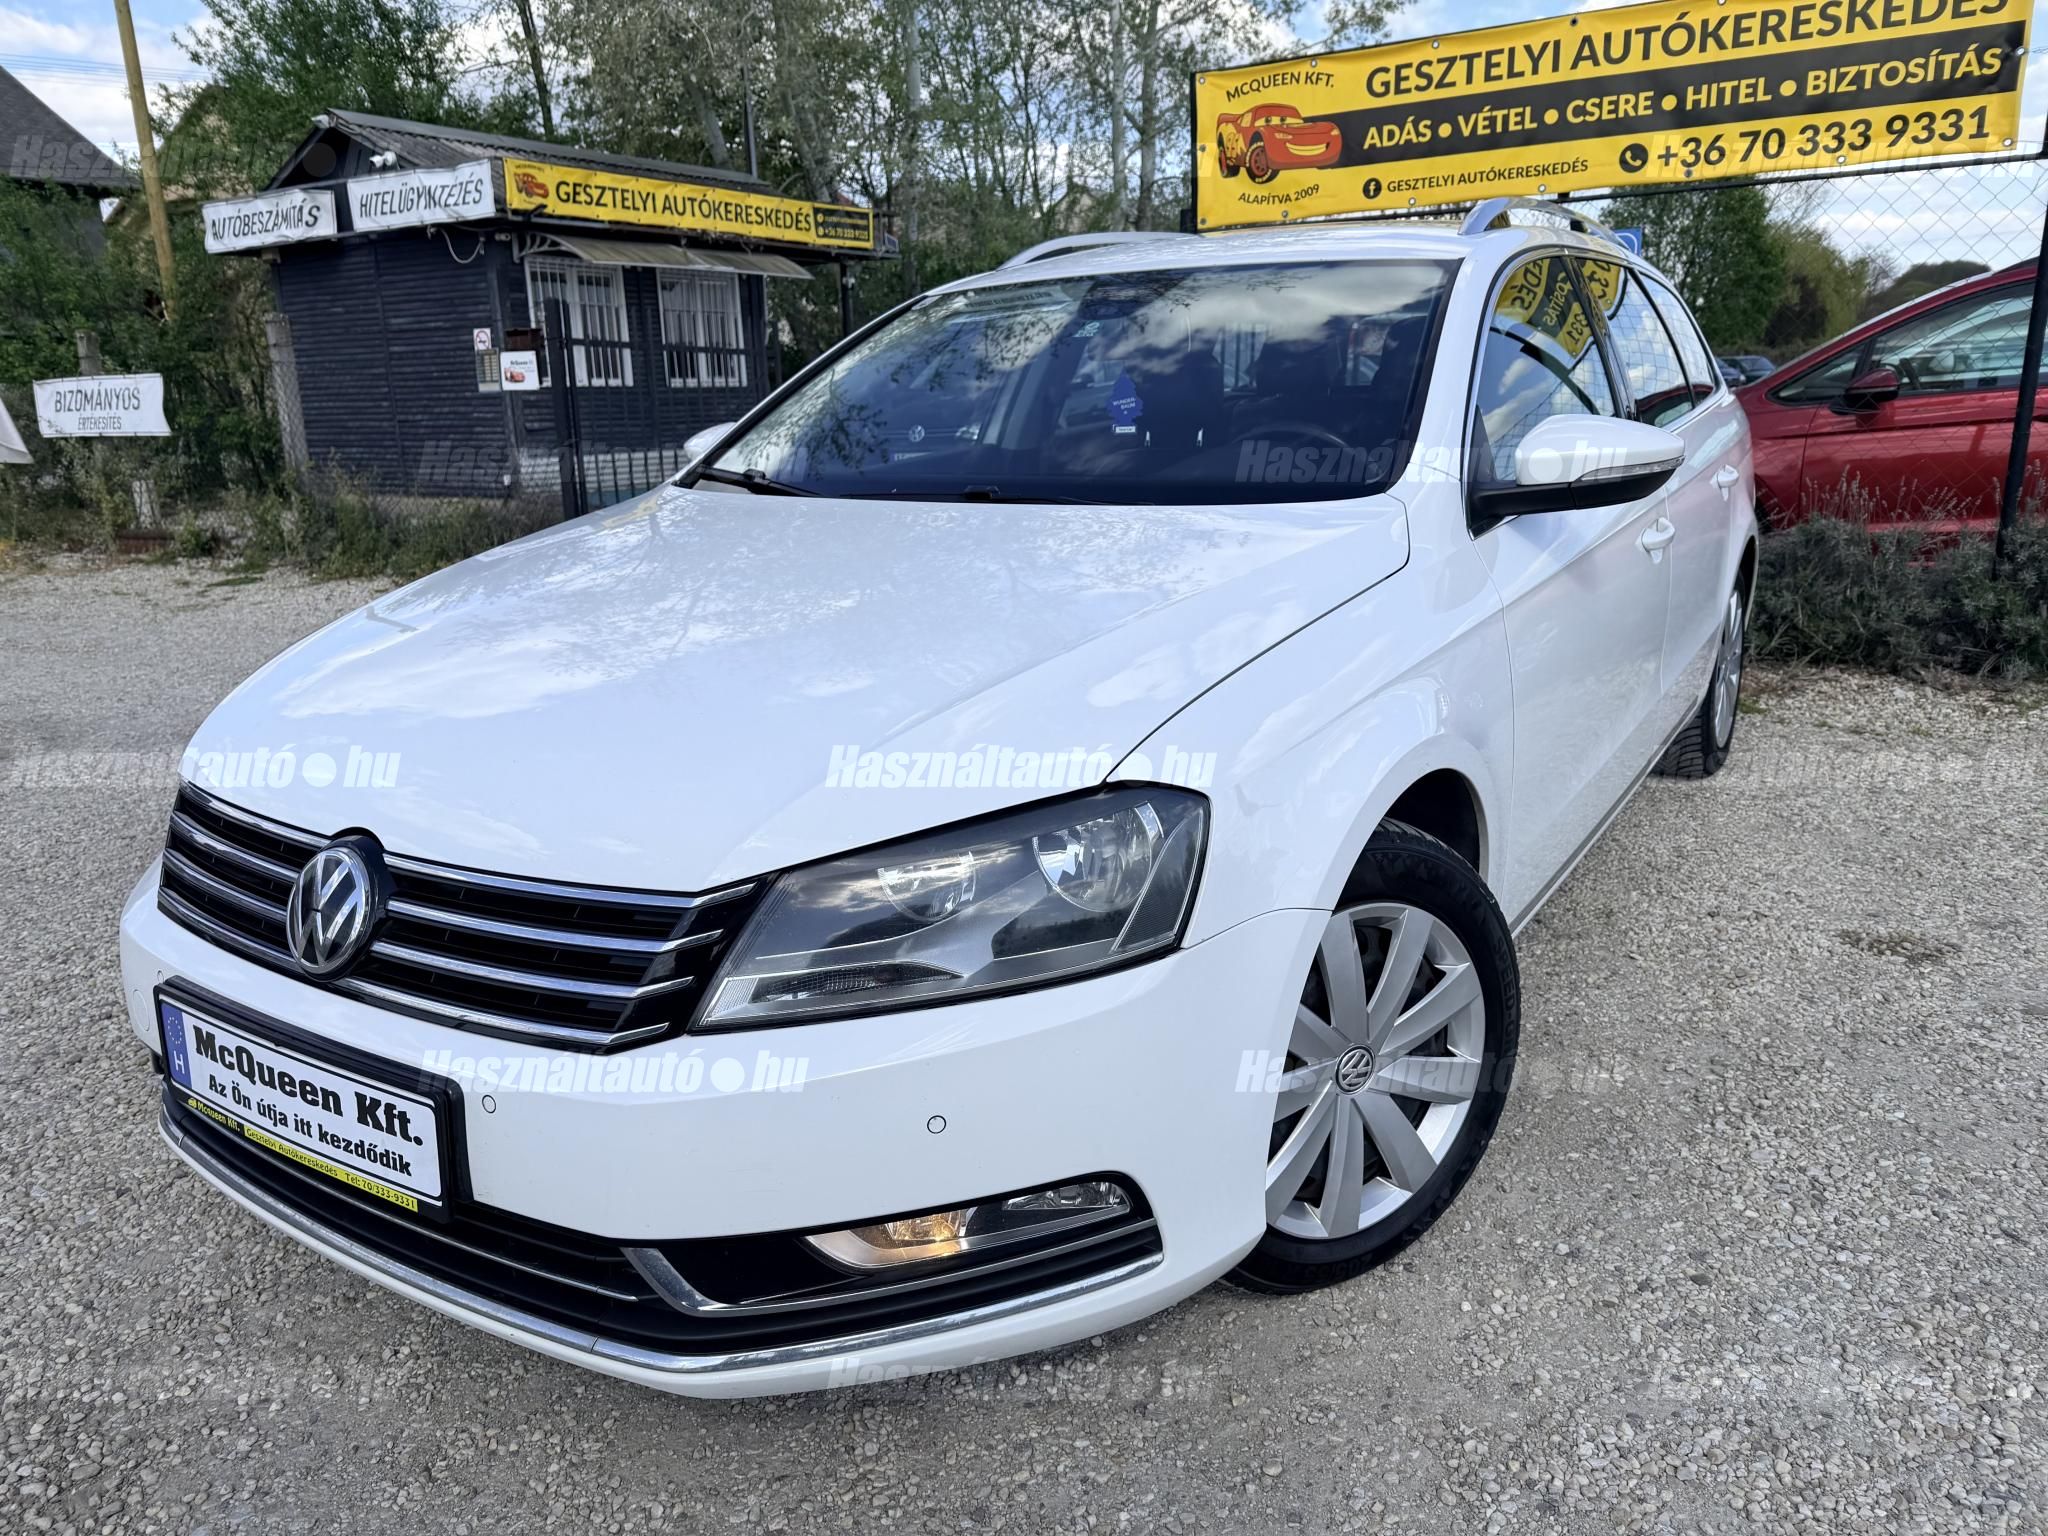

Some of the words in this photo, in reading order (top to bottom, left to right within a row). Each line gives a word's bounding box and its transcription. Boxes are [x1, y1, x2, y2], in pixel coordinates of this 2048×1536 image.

[1226, 71, 1301, 103] MCQUEEN
[1304, 71, 1335, 88] KFT.
[1366, 39, 1562, 98] GESZTELYI
[1362, 116, 1432, 150] ADÁS
[1457, 106, 1538, 138] VÉTEL
[1566, 91, 1654, 123] CSERE
[1685, 77, 1772, 111] HITEL
[1806, 43, 2002, 96] BIZTOSÍTÁS
[1657, 133, 1726, 169] +36
[1739, 128, 1786, 162] 70
[1797, 118, 1872, 156] 333
[1886, 105, 1990, 147] 9331
[359, 172, 483, 218] HITELÜGYINTÉZÉS
[1238, 192, 1293, 205] ALAPÍTVA
[1294, 183, 1320, 201] 2009
[1387, 174, 1455, 193] GESZTELYI
[1457, 157, 1588, 186] AUTÓKERESKEDÉS
[211, 198, 321, 241] AUTÓBESZÁMÍTÁS
[556, 181, 658, 213] GESZTELYI
[662, 194, 812, 232] AUTÓKERESKEDÉS
[55, 383, 140, 413] BIZOMÁNYOS
[78, 412, 122, 431] ÉRTÉKESÍTÉS
[173, 1051, 185, 1075] H
[193, 1024, 343, 1117] McQueen
[354, 1091, 423, 1146] Kft.
[209, 1073, 228, 1098] Az
[231, 1080, 252, 1111] Ön
[257, 1098, 289, 1128] útja
[293, 1113, 313, 1138] itt
[318, 1123, 412, 1177] kezdődik
